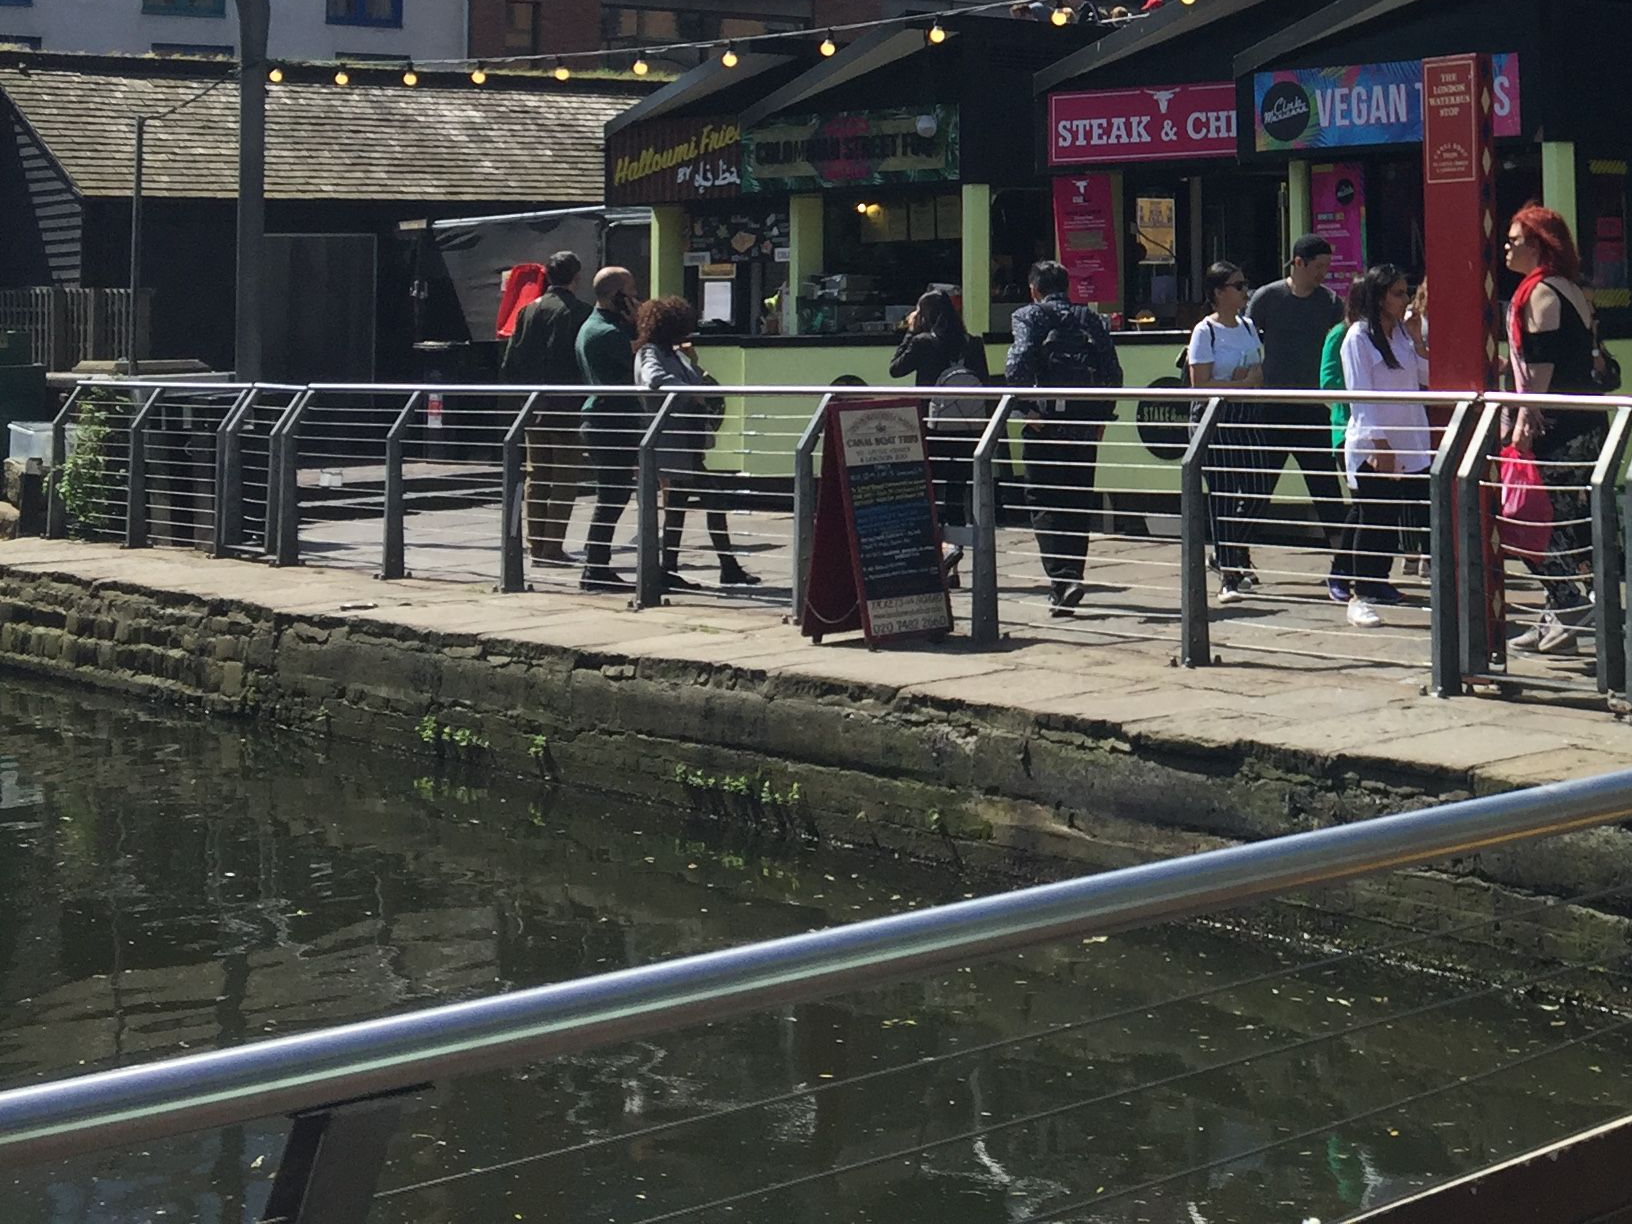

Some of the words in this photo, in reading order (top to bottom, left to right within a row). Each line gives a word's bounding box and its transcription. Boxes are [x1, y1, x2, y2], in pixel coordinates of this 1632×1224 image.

[1440, 73, 1458, 83] THE
[1433, 83, 1466, 95] LONDON
[1315, 83, 1408, 129] VEGAN
[1429, 96, 1471, 107] WATERBUS
[1440, 107, 1460, 117] STOP
[1057, 114, 1152, 149] STEAK
[1160, 116, 1178, 142] &
[614, 136, 699, 187] Halloumi
